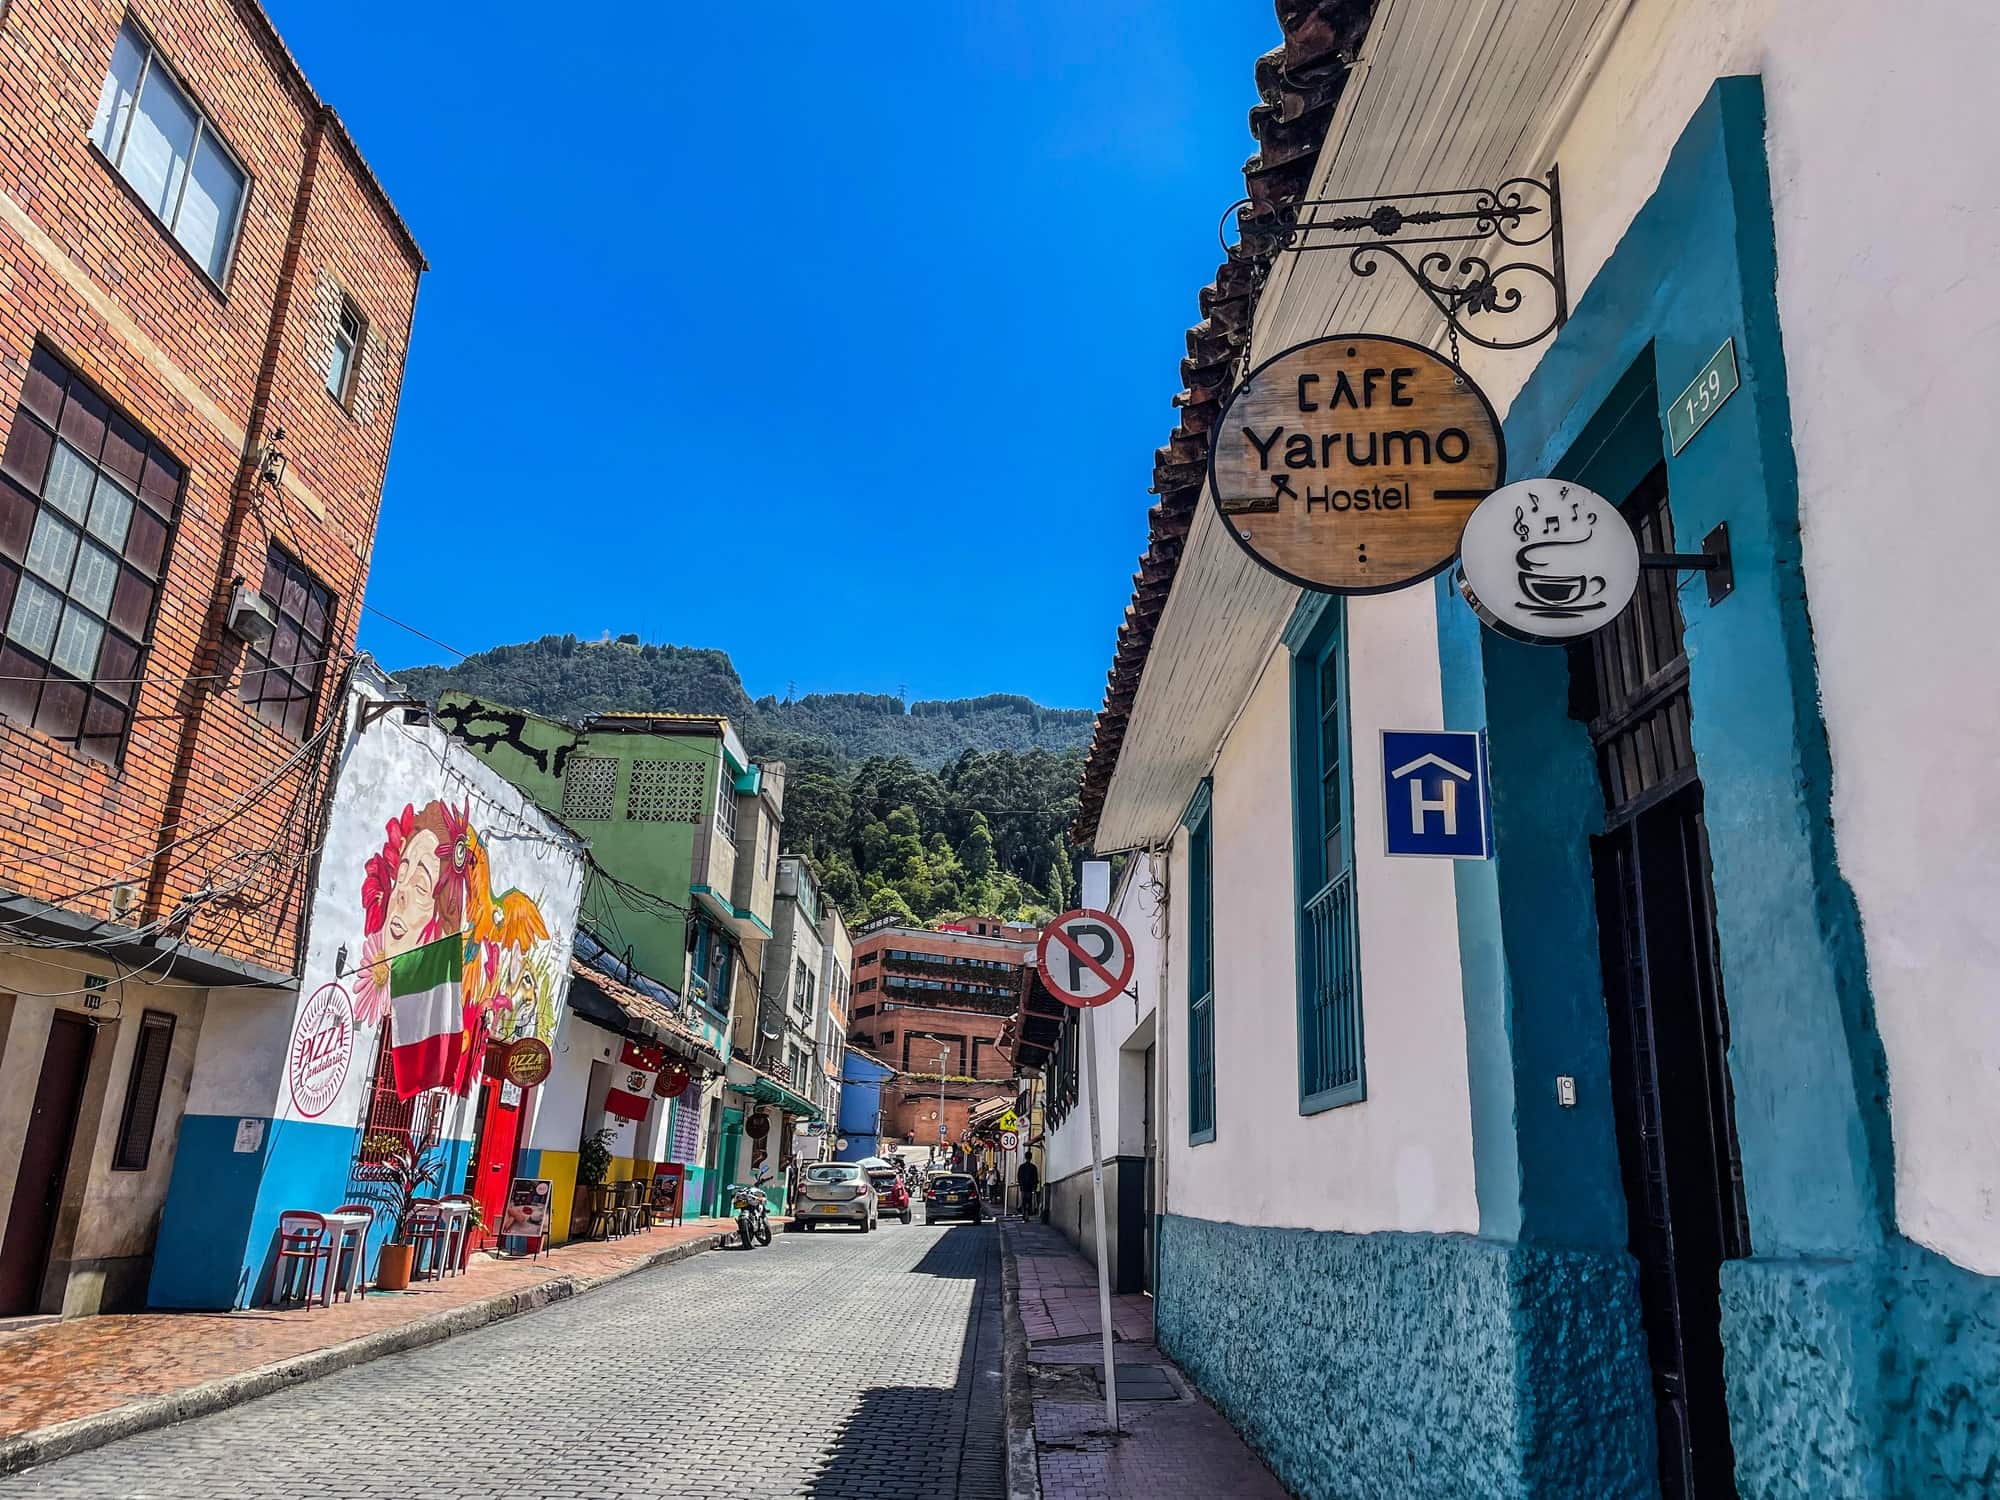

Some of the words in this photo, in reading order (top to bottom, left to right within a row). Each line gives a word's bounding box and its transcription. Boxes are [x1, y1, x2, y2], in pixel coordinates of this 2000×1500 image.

[1298, 367, 1416, 412] CAFE
[1686, 369, 1720, 424] 1-59
[1242, 426, 1470, 470] Yarumo
[1307, 483, 1409, 514] Hostel
[1410, 778, 1456, 835] H
[1067, 925, 1113, 991] P
[298, 1022, 345, 1069] PIZZA
[508, 1053, 543, 1067] PIZZA
[300, 1052, 343, 1087] Candelaria
[1003, 1135, 1016, 1146] 30
